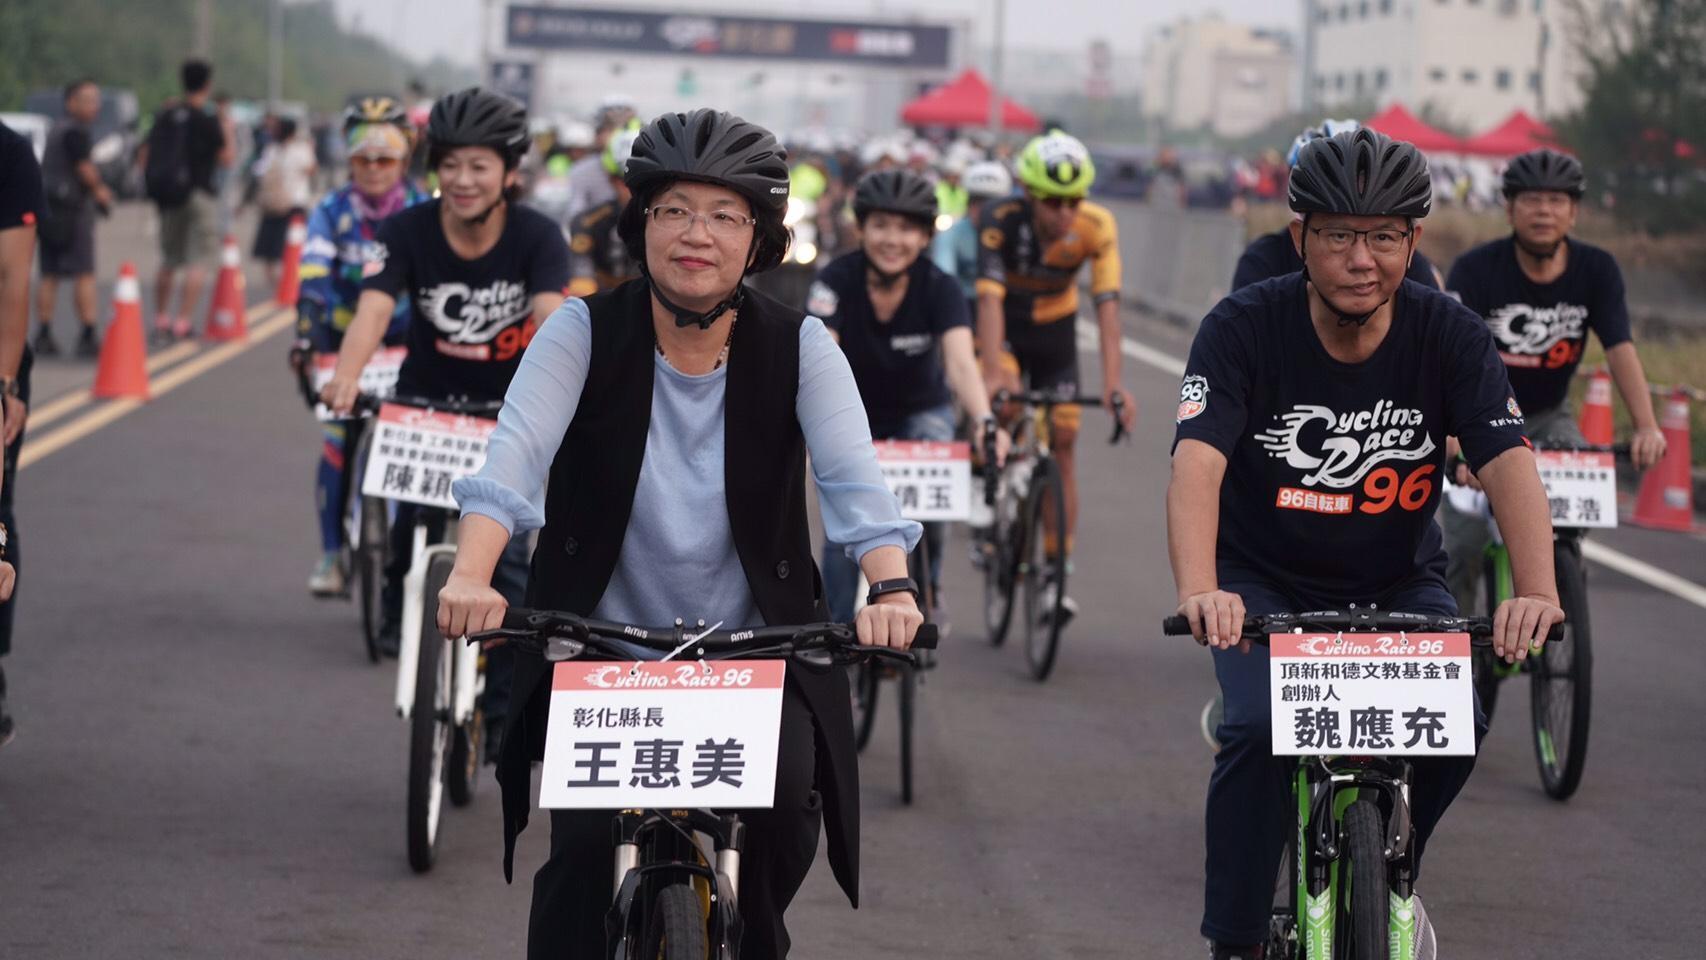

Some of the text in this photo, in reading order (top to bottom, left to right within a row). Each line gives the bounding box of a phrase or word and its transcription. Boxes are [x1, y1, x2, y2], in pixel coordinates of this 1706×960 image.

[1180, 382, 1203, 401] 96
[1302, 428, 1420, 488] Race
[1359, 464, 1436, 514] 96
[1279, 488, 1350, 513] 96自転車
[1418, 640, 1444, 654] 96
[722, 668, 753, 687] 96
[1280, 662, 1462, 680] 頂新和德文教基金會
[1281, 684, 1341, 702] 創辦人
[573, 707, 665, 728] 彰化縣長
[1294, 706, 1450, 749] 魏應充
[567, 738, 746, 789] 王惠美
